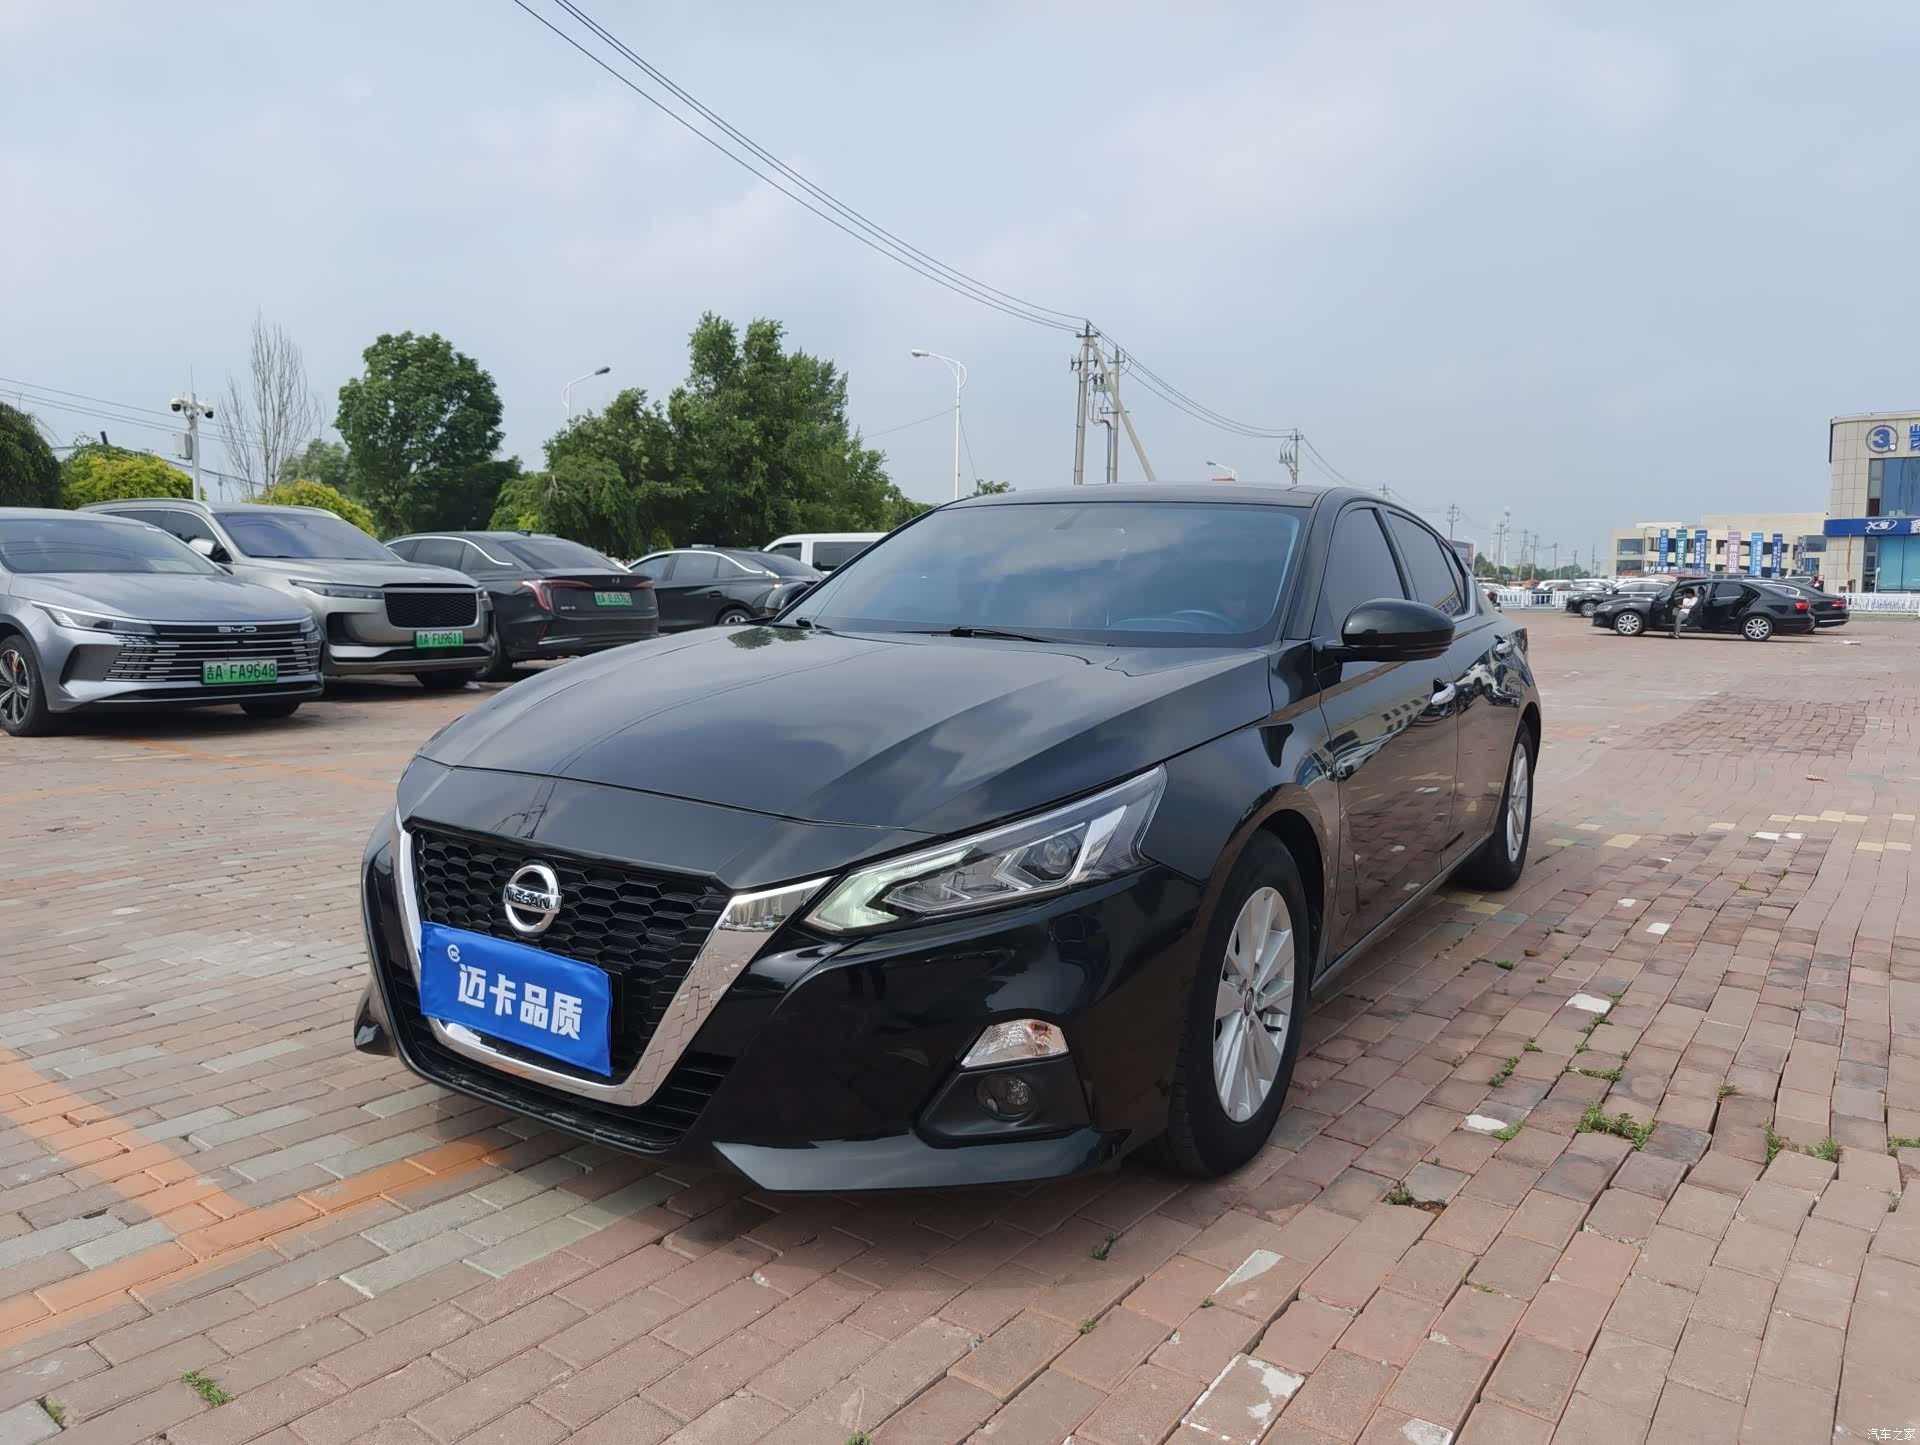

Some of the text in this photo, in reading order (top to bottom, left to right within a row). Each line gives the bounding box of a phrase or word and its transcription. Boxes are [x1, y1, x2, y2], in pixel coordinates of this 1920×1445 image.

[230, 663, 276, 680] FA9648
[505, 890, 550, 909] NISSAN
[457, 963, 583, 1041] 迈卡品质
